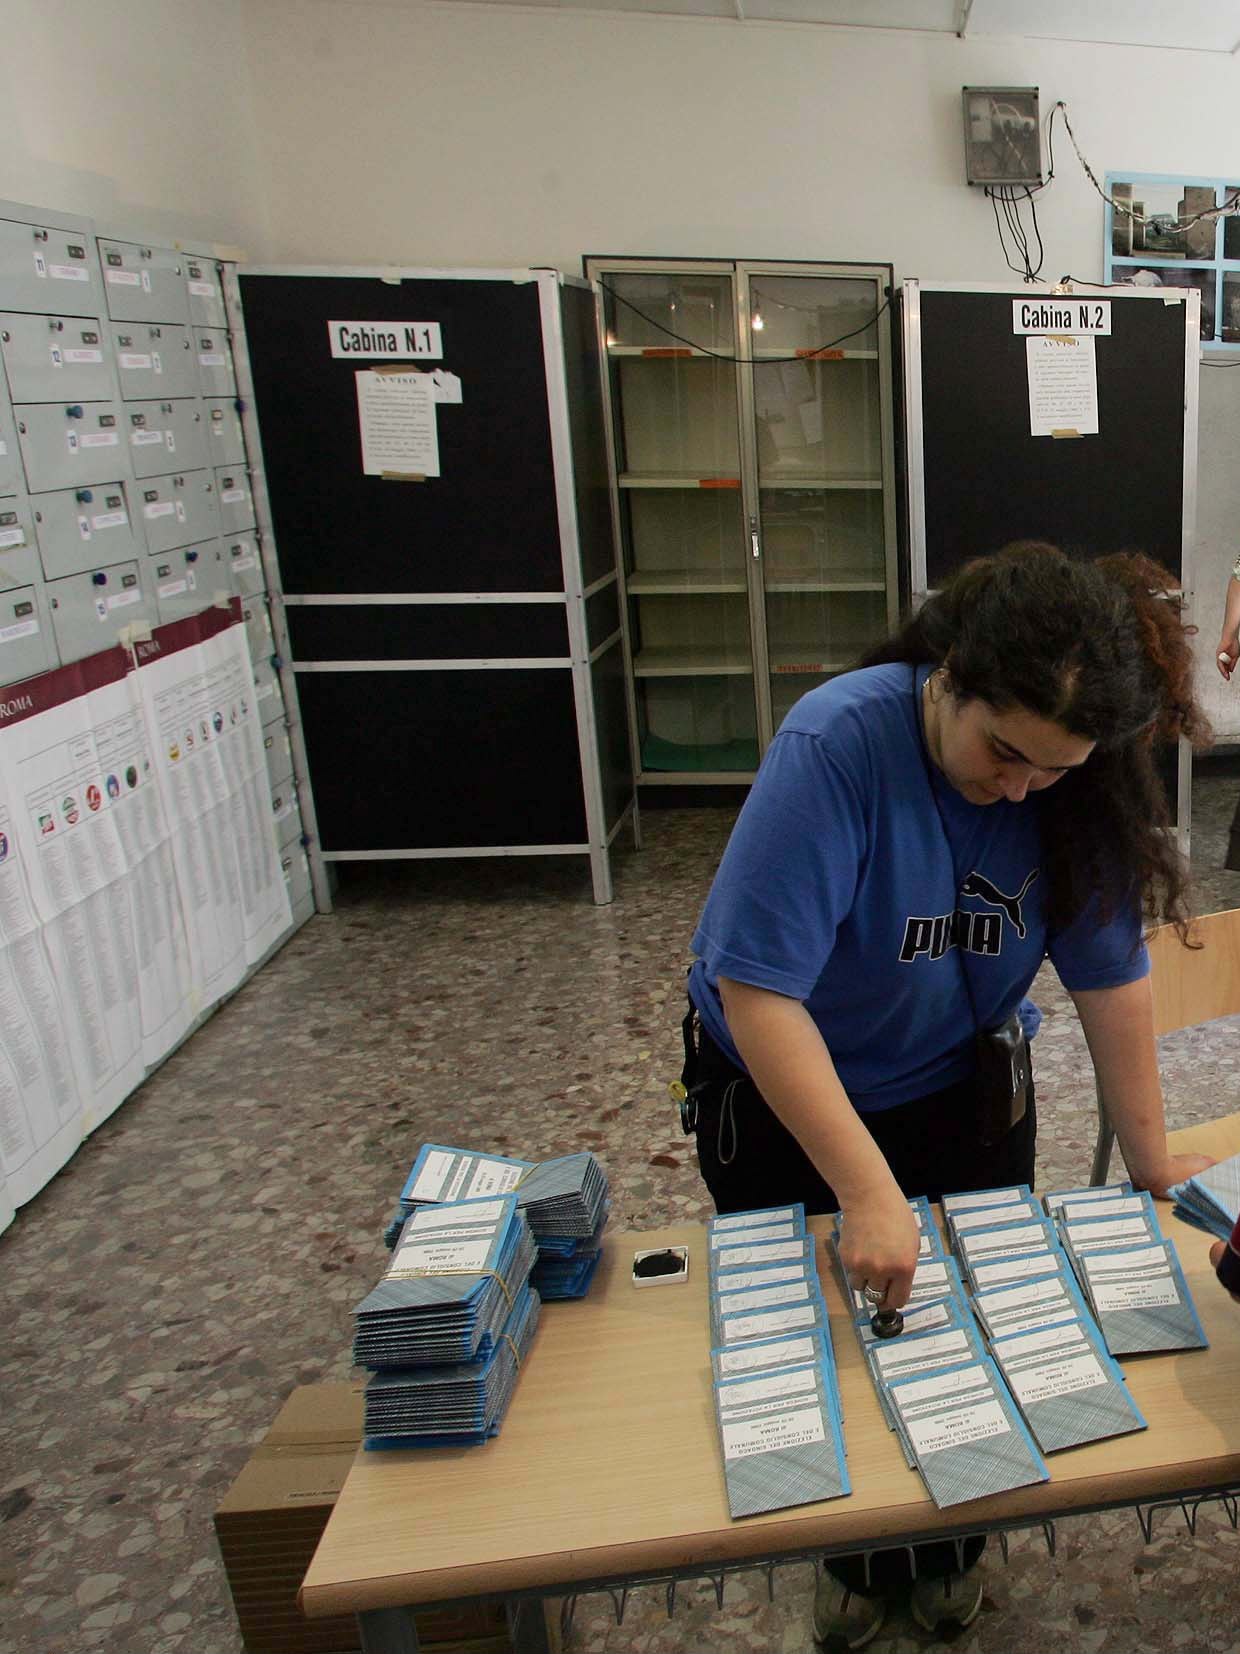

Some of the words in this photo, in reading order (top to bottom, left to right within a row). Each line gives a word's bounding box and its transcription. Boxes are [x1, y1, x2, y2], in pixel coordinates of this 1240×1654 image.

[1021, 304, 1072, 329] Cabina
[1079, 305, 1104, 329] N.2
[339, 326, 398, 353] Cabina
[405, 327, 432, 353] N.1
[1043, 340, 1080, 348] AVVIO
[0, 695, 33, 719] ROMA
